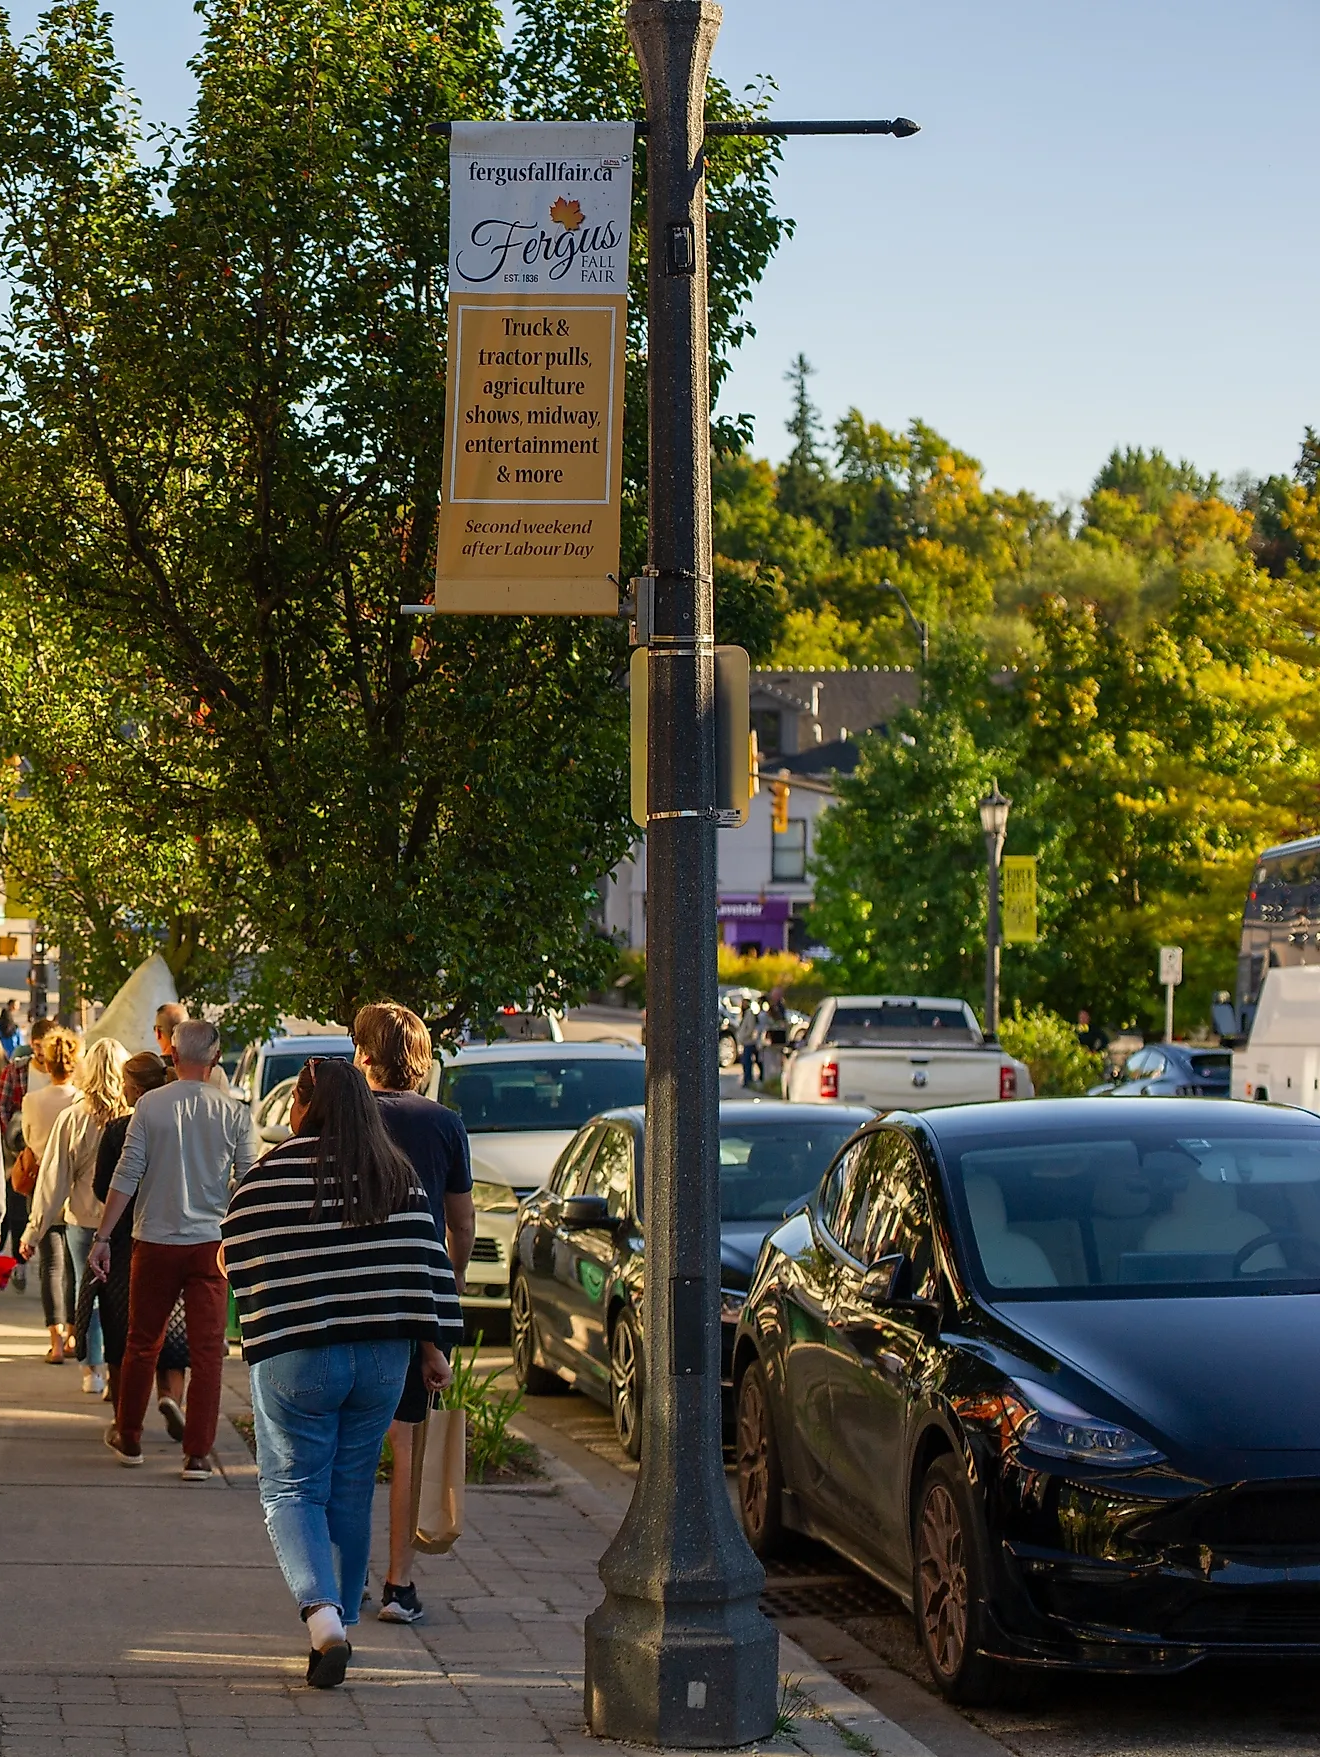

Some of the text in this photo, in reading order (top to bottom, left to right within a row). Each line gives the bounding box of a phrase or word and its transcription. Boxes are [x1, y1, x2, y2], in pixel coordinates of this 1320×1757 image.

[469, 162, 612, 186] fergusfallfair.ca
[456, 219, 622, 282] Fergus
[581, 256, 615, 268] FALL
[503, 273, 539, 283] EST. 1836
[581, 270, 616, 283] FAIR
[501, 317, 570, 337] Truck &
[478, 346, 592, 370] tractor pulls,
[483, 376, 584, 399] agriculture
[465, 405, 601, 429] shows, midway,
[464, 436, 599, 454] entertainment
[496, 465, 563, 483] & more
[464, 519, 592, 535] Second weekend
[462, 541, 594, 560] after Labour Day
